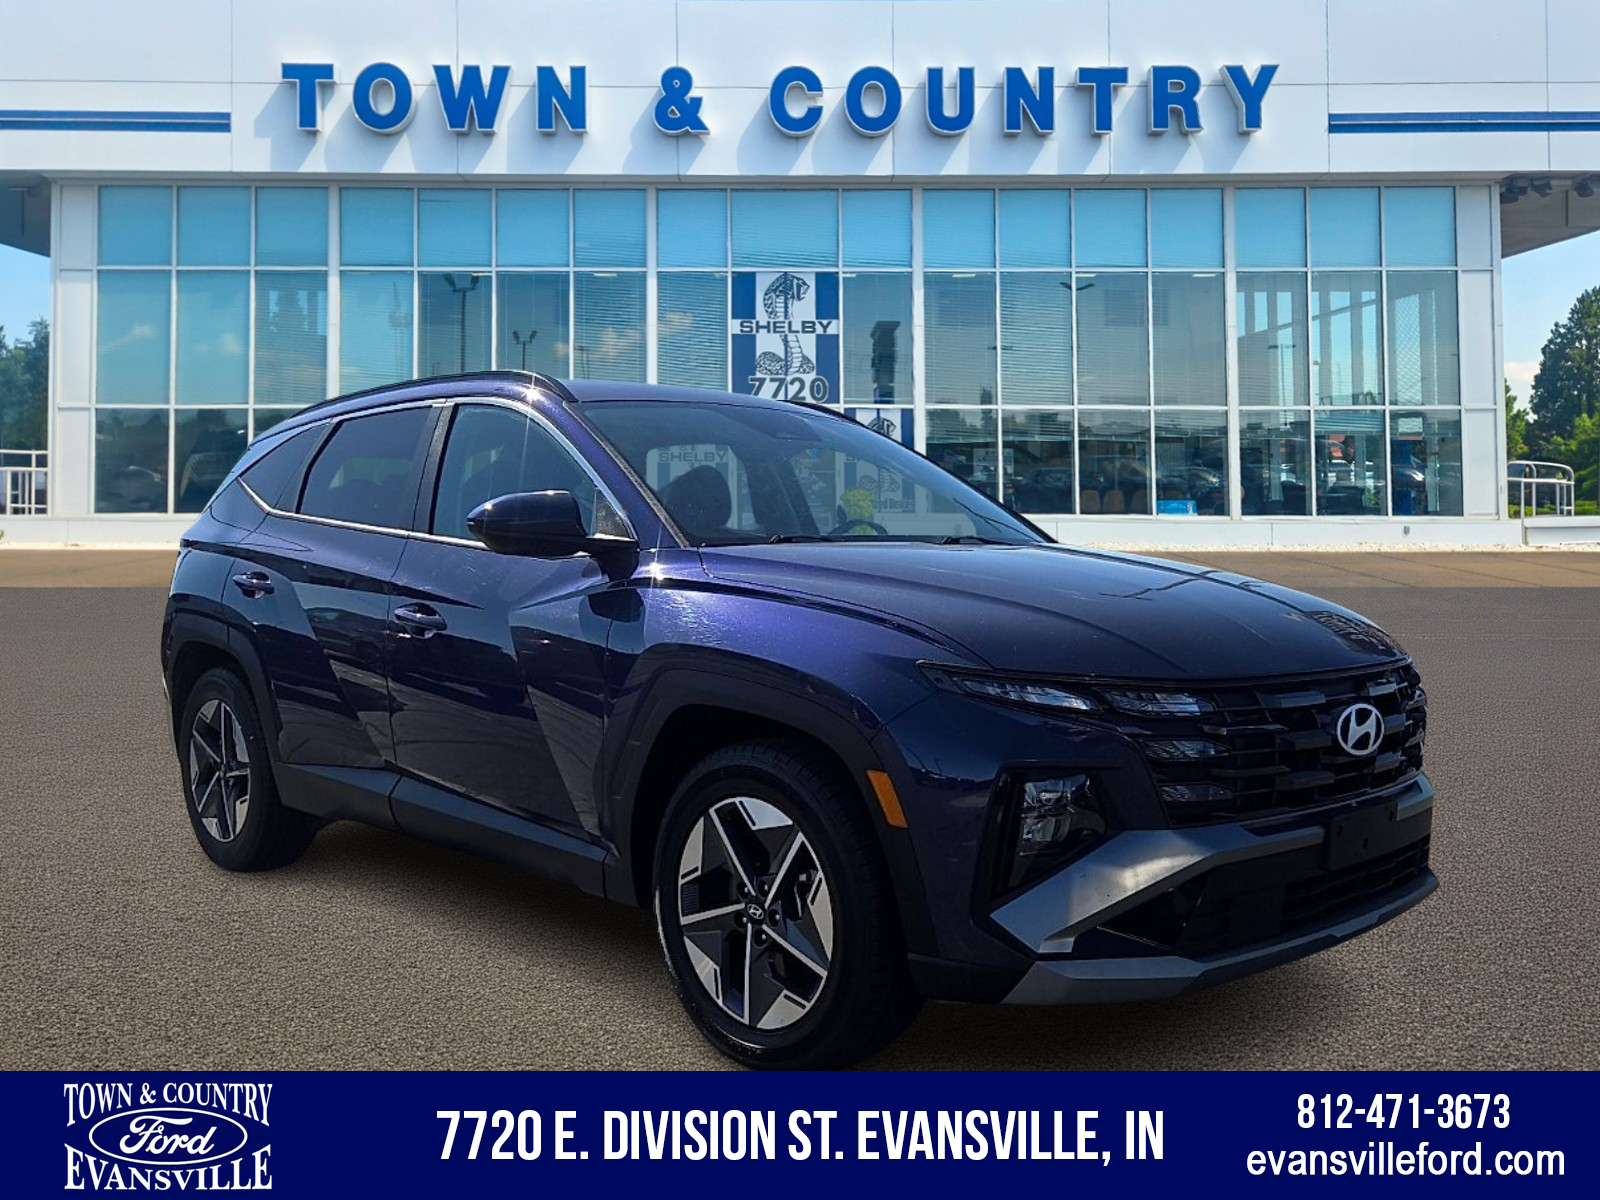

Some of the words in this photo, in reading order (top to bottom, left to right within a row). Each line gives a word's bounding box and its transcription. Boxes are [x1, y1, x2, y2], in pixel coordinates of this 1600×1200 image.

[281, 63, 588, 134] TOWN
[653, 66, 710, 135] &
[768, 64, 1280, 137] COUNTRY
[740, 320, 832, 334] SHELBY
[748, 375, 829, 404] 7720
[659, 451, 727, 462] SHELBY
